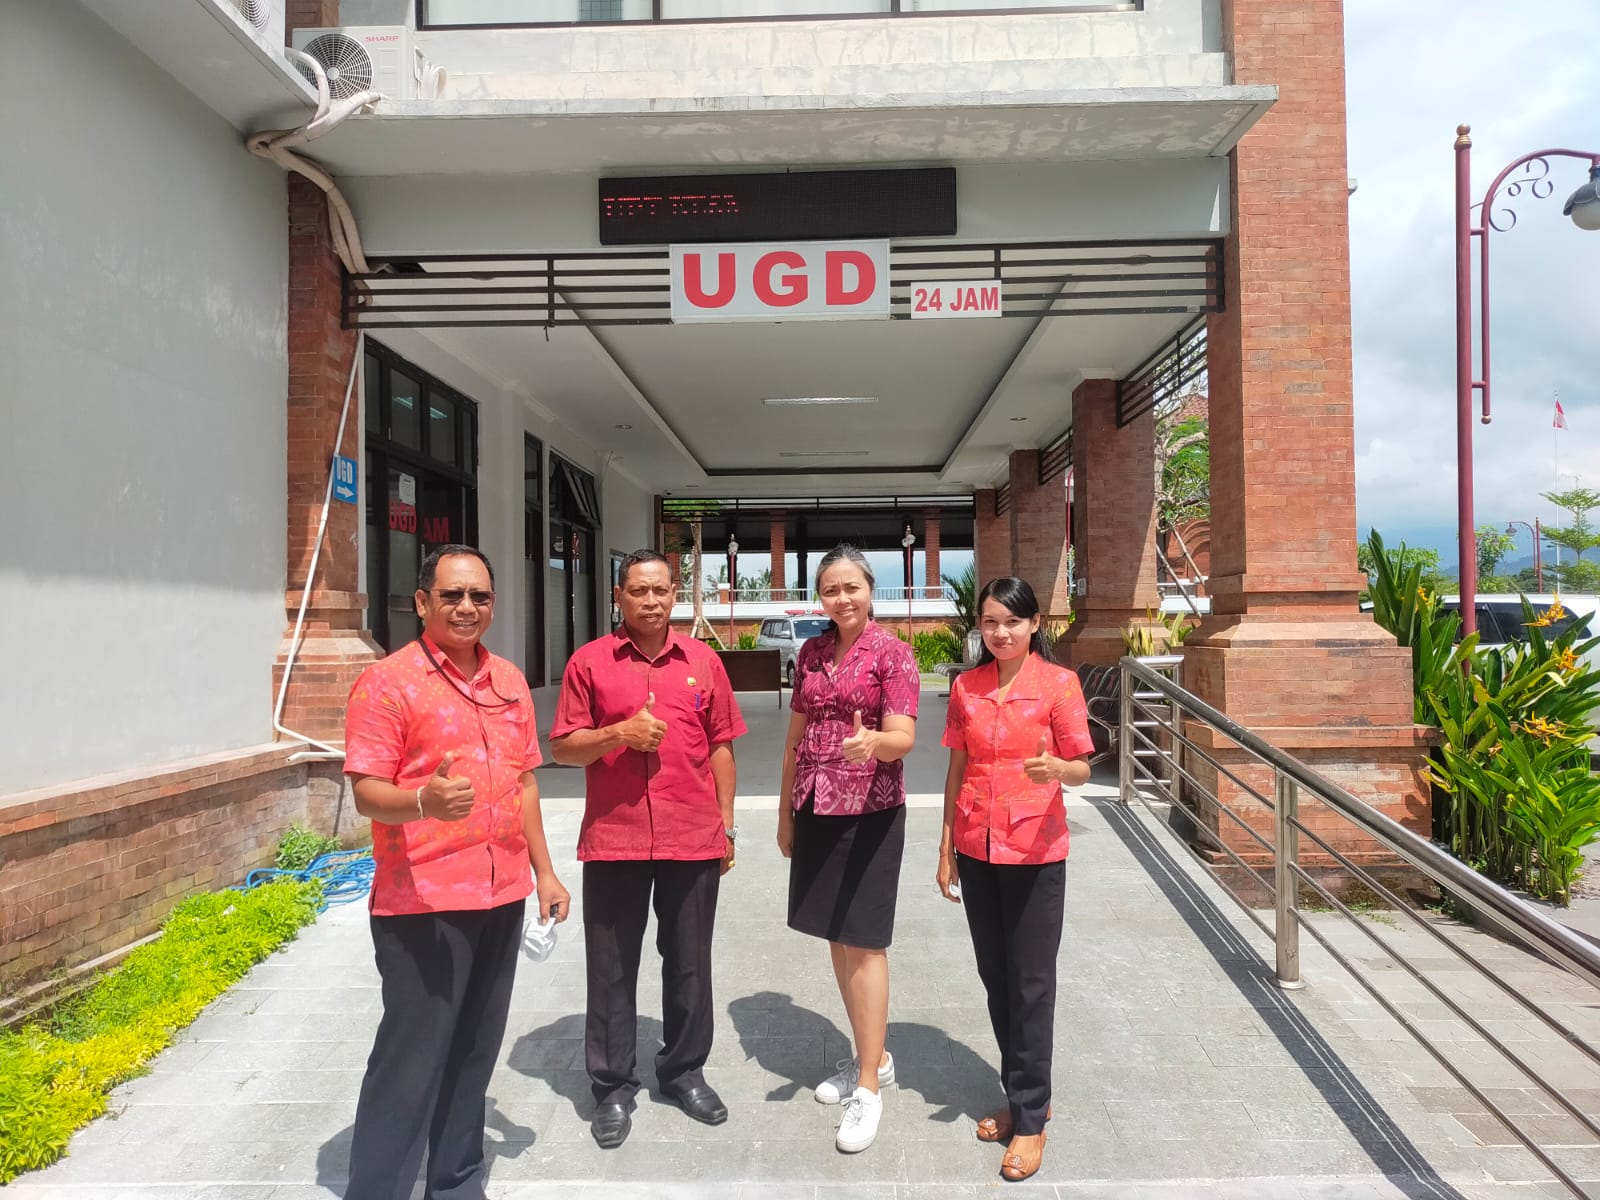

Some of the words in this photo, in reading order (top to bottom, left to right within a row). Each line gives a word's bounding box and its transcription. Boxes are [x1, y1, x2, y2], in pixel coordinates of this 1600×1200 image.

[683, 250, 876, 308] UGD
[914, 288, 942, 312] 24
[950, 287, 999, 311] JAM
[336, 456, 353, 484] UGD
